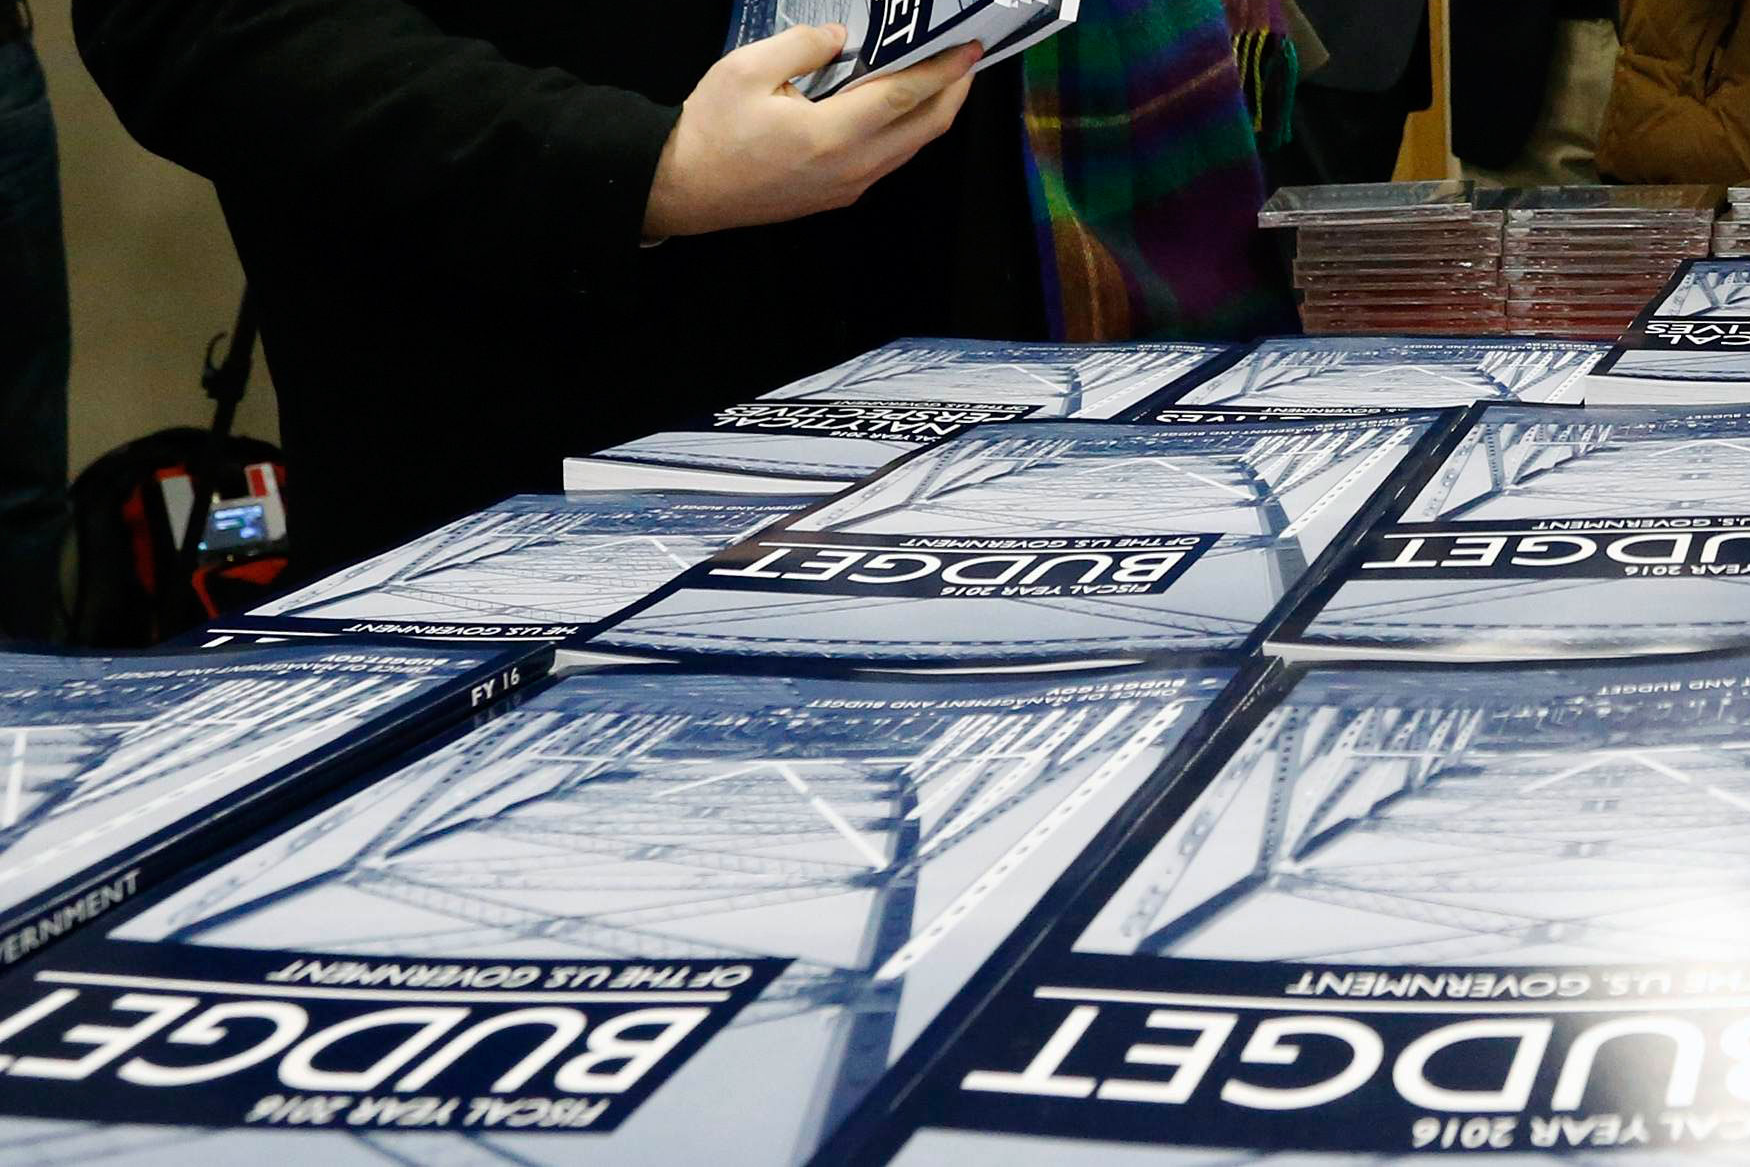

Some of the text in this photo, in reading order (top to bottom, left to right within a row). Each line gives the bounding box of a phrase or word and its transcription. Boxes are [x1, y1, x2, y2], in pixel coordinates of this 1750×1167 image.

[713, 416, 961, 436] NALYTICAL
[1532, 518, 1712, 529] GOVERNMENT
[899, 537, 1201, 549] OF THE U.S. GOVERNMENT
[708, 548, 1186, 585] BUDGET
[1624, 565, 1682, 576] 2016
[940, 582, 1152, 596] FISCAL YEAR 2016
[342, 624, 502, 635] GOVERNMENT
[509, 625, 542, 635] U.S.
[471, 669, 520, 708] FY 16
[1046, 678, 1187, 696] BUDGET.GOV
[1598, 681, 1682, 695] BUDGET
[1689, 679, 1737, 691] AND
[808, 689, 1179, 709] OFFICE OF MANAGEMENT AND BUDGET
[264, 959, 541, 987] GOVERNMENT
[612, 964, 691, 988] THE
[693, 964, 754, 988] OF
[1286, 970, 1593, 998] GOVERNMENT
[1601, 972, 1674, 996] U.S.
[245, 1094, 611, 1128] FISCAL YEAR 2016
[1412, 1116, 1519, 1150] 2016
[1531, 1113, 1648, 1147] YEAR
